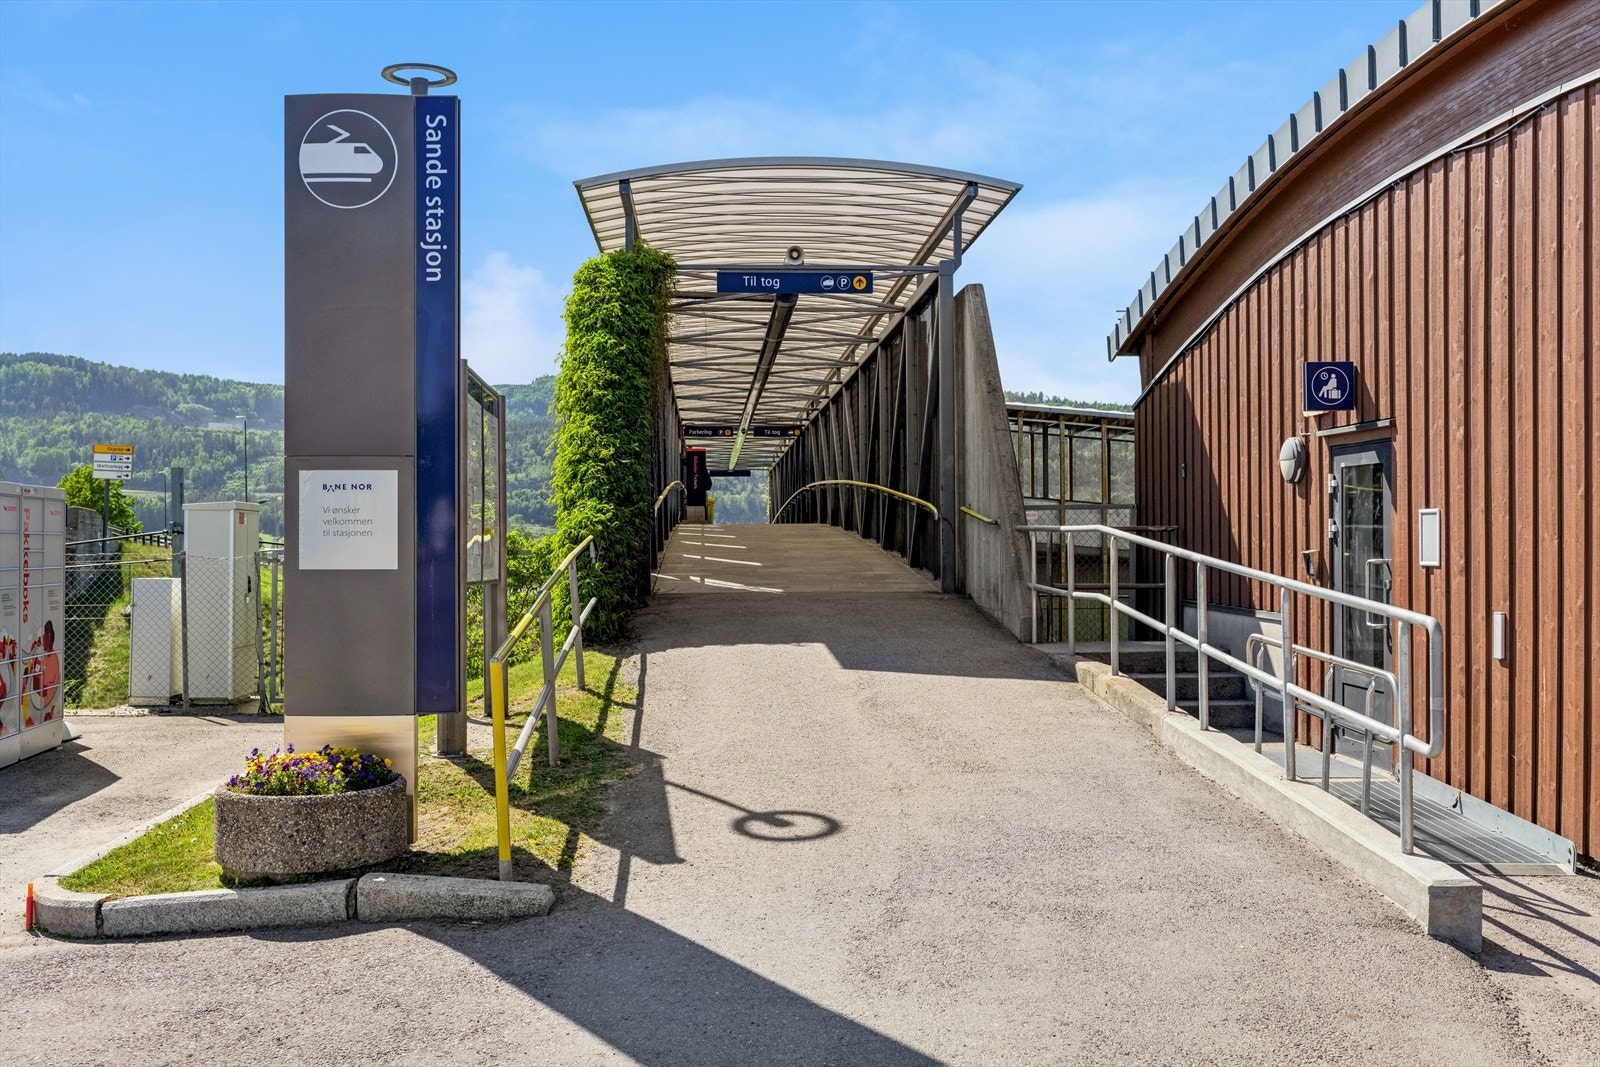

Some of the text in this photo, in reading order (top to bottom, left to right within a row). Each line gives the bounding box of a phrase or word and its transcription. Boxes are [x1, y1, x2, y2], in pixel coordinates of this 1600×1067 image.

[420, 114, 448, 282] Sande stasjon
[742, 275, 848, 289] Til tog P
[322, 484, 347, 492] BANE
[322, 506, 361, 514] Vi ønsker
[322, 517, 373, 525] velkommen
[322, 529, 373, 538] til stasjonen
